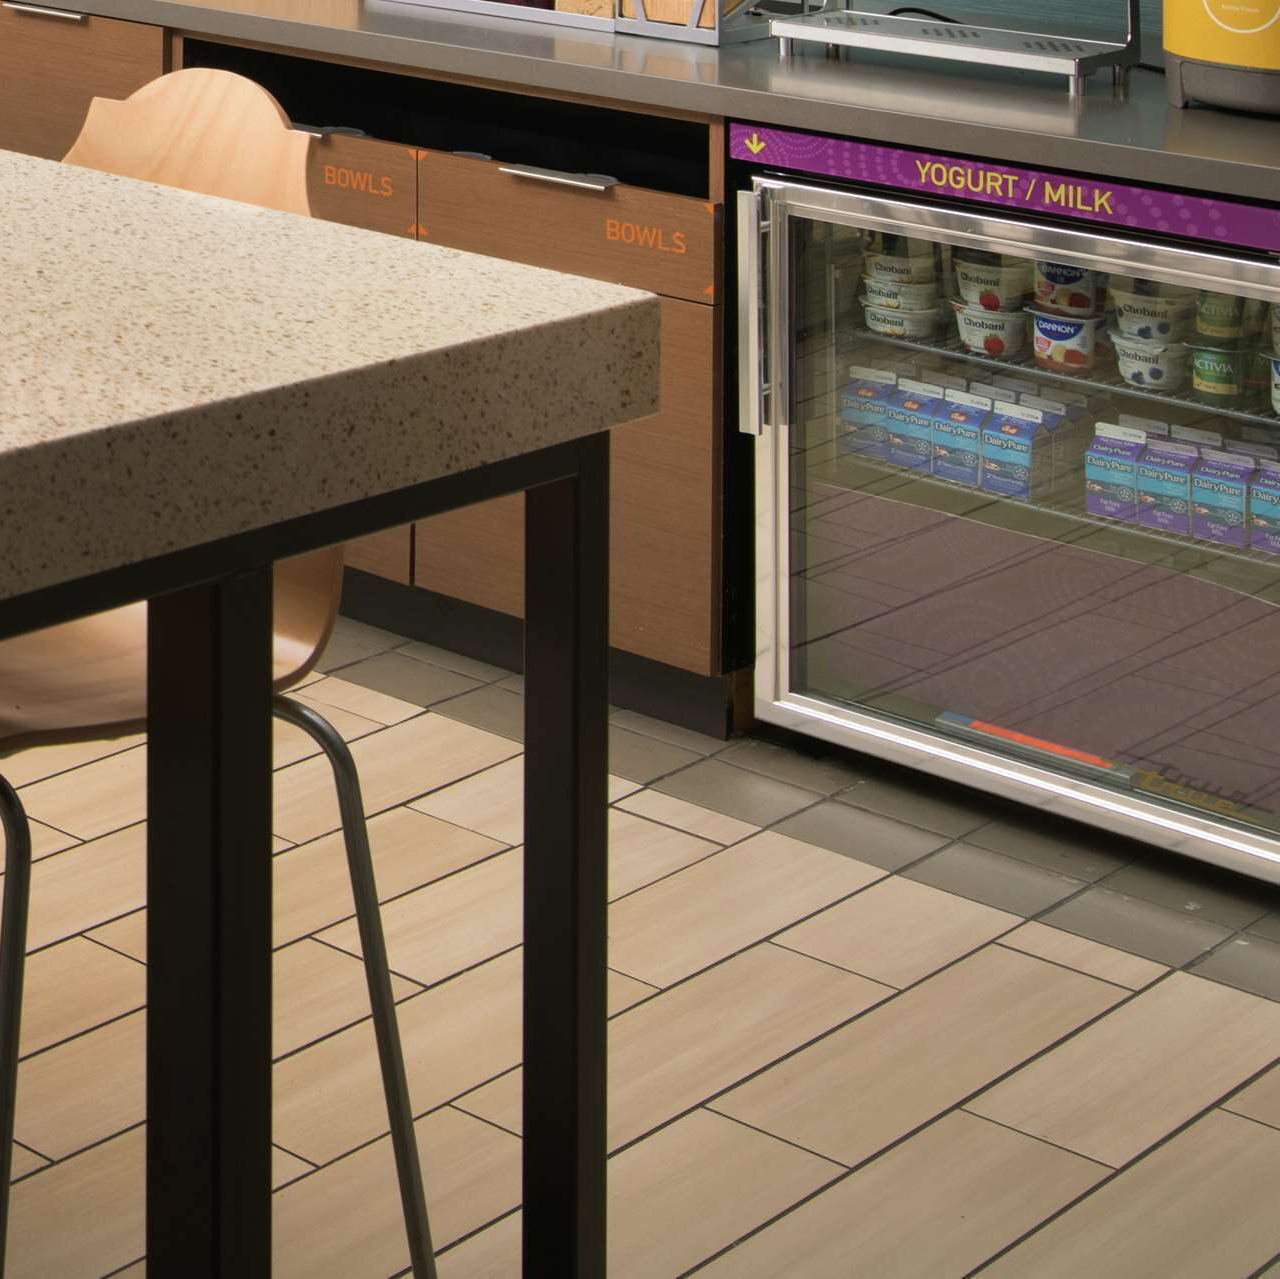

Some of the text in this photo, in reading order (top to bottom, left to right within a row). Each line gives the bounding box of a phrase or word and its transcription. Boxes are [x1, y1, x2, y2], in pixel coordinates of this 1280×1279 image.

[324, 166, 394, 198] BOWLS
[915, 160, 1018, 198] YOGURT
[1044, 181, 1113, 215] MILK
[605, 218, 687, 255] BOWLS
[960, 272, 1000, 287] Chobani
[1122, 303, 1168, 319] Chobani
[870, 313, 904, 328] Chobani
[963, 316, 1005, 332] Chobani
[1038, 321, 1074, 334] DANNON
[888, 410, 930, 426] DairyPure
[934, 421, 977, 439] DairyPure
[984, 433, 1028, 452] DairyPure
[1087, 455, 1133, 472] DairyPure
[1139, 467, 1186, 484] DairyPure
[1194, 479, 1241, 496] DairyPure
[1253, 489, 1280, 506] Dairy
